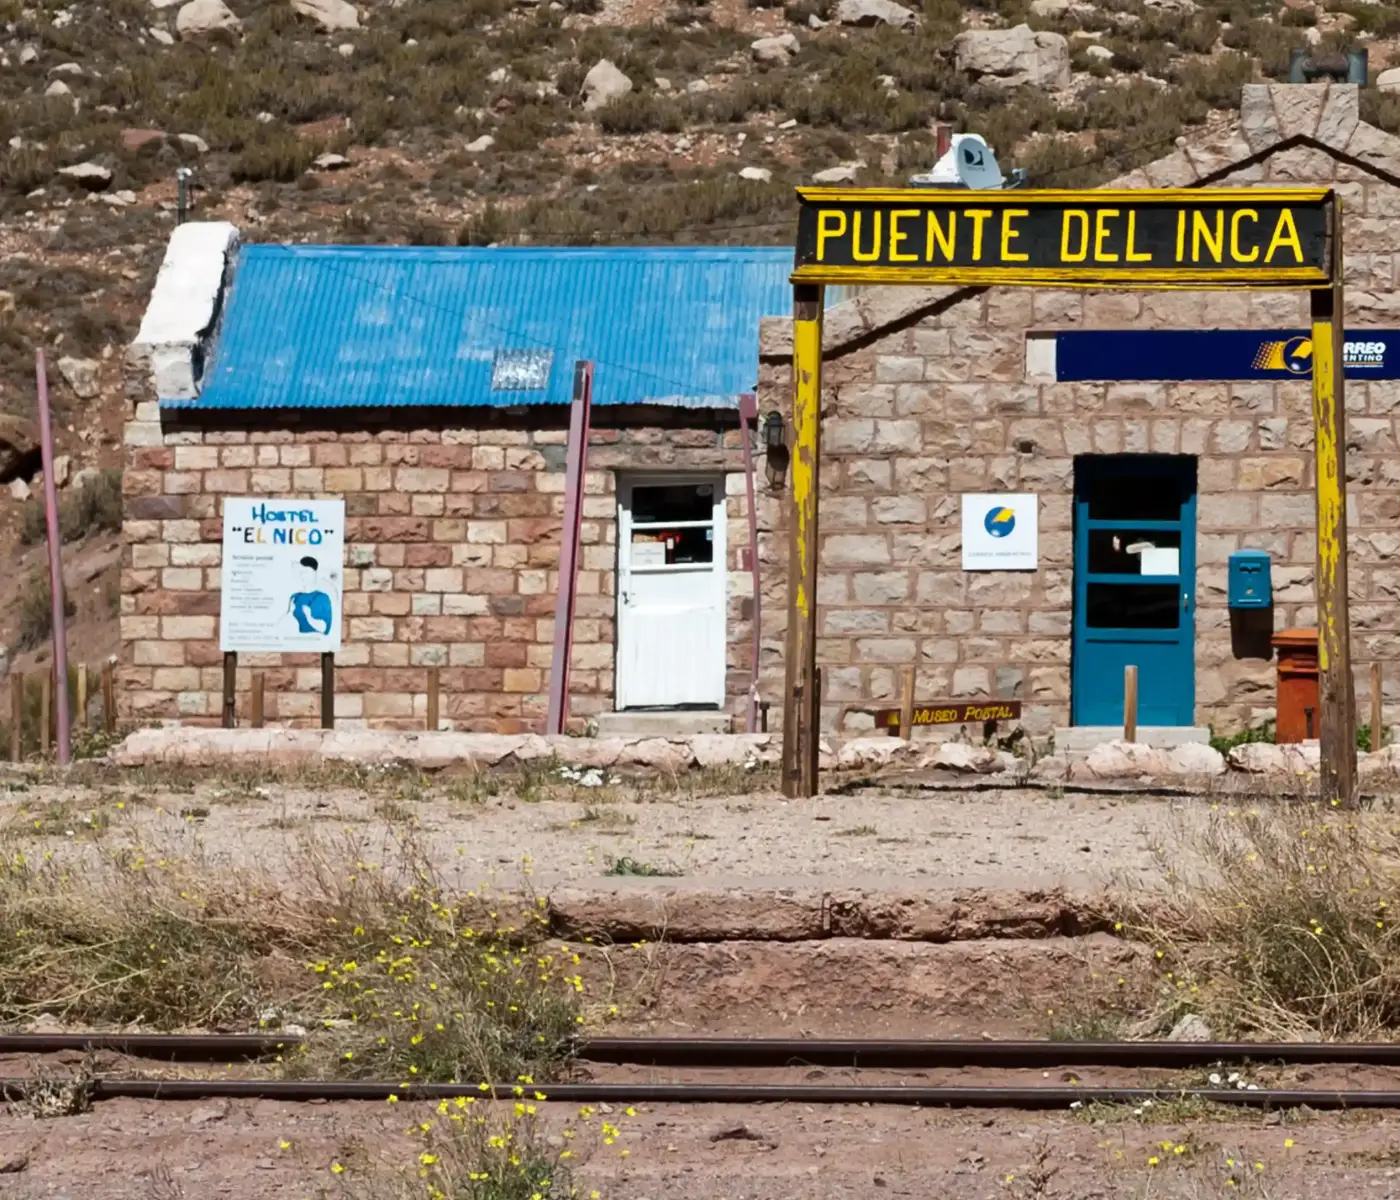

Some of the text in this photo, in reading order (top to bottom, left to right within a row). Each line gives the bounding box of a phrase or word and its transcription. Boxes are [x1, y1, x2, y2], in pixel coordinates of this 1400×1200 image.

[815, 207, 1305, 262] PUENTE DEL INCA
[1343, 342, 1386, 354] RREO
[912, 709, 958, 724] MUSEO
